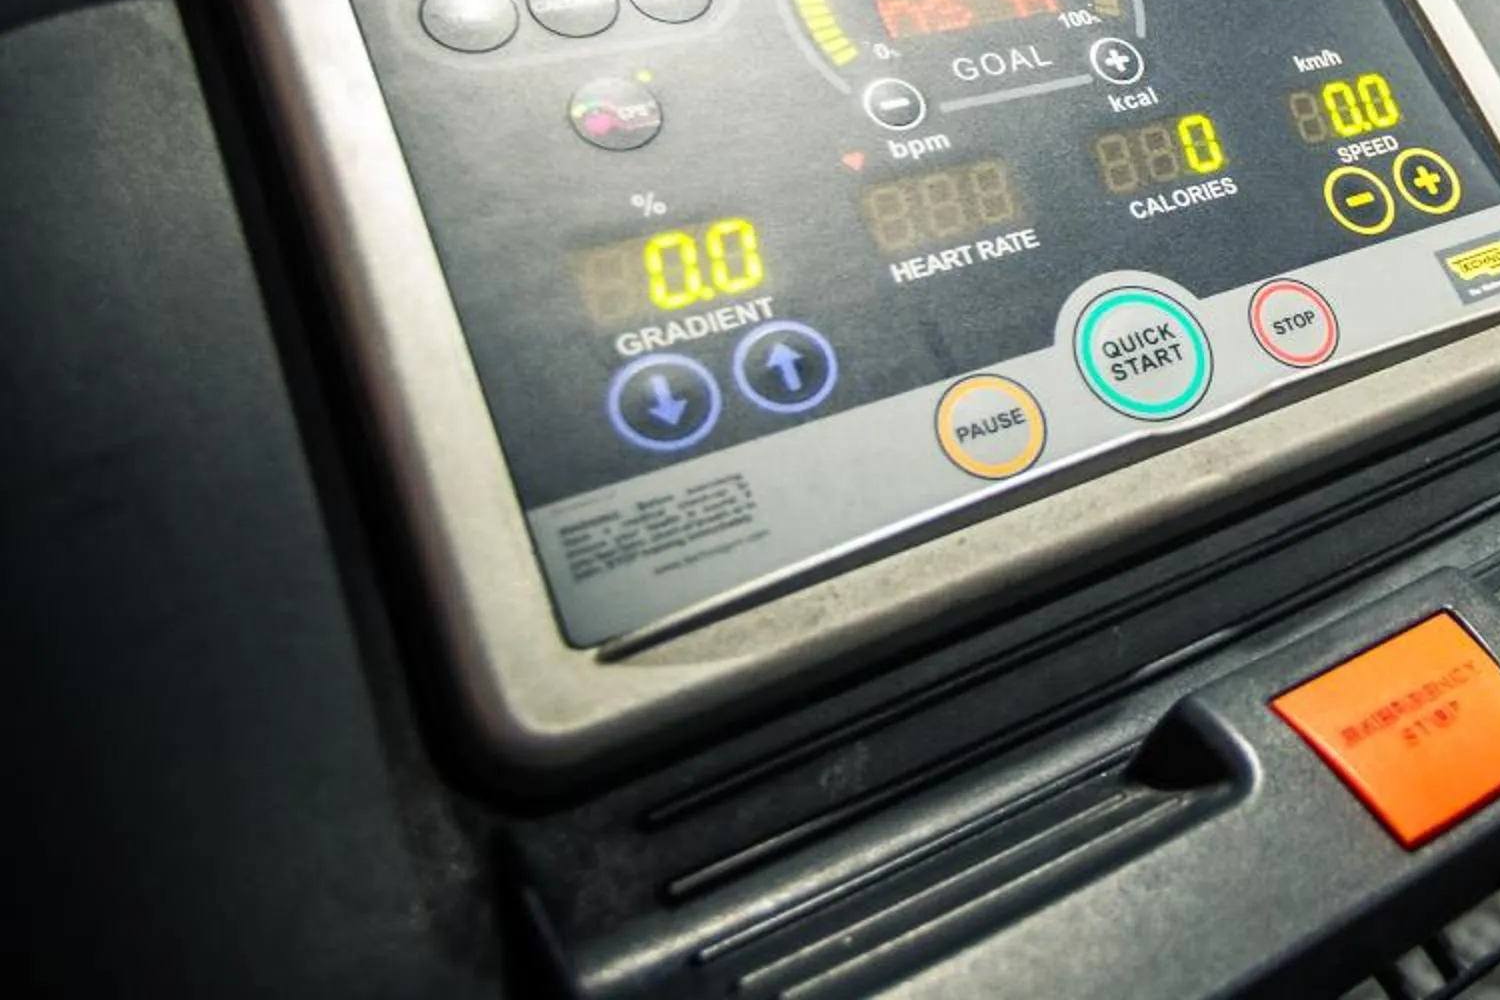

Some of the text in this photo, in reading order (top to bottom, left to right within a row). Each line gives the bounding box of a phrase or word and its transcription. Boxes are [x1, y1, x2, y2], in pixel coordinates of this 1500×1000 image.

[952, 46, 1053, 82] GOAL
[1293, 50, 1344, 74] km/h
[1108, 87, 1159, 113] kcal
[888, 133, 951, 159] bpm
[1177, 113, 1225, 174] 0
[1337, 136, 1400, 164] SPEED
[631, 194, 667, 216] %
[1129, 178, 1239, 219] CALORIES
[644, 217, 764, 310] 0.0
[889, 230, 1041, 284] HEART RATE
[615, 298, 775, 355] GRADIENT
[1102, 322, 1177, 360] QUICK
[1272, 310, 1316, 336] STOP
[1111, 343, 1184, 382] START
[955, 407, 1027, 444] PAUSE
